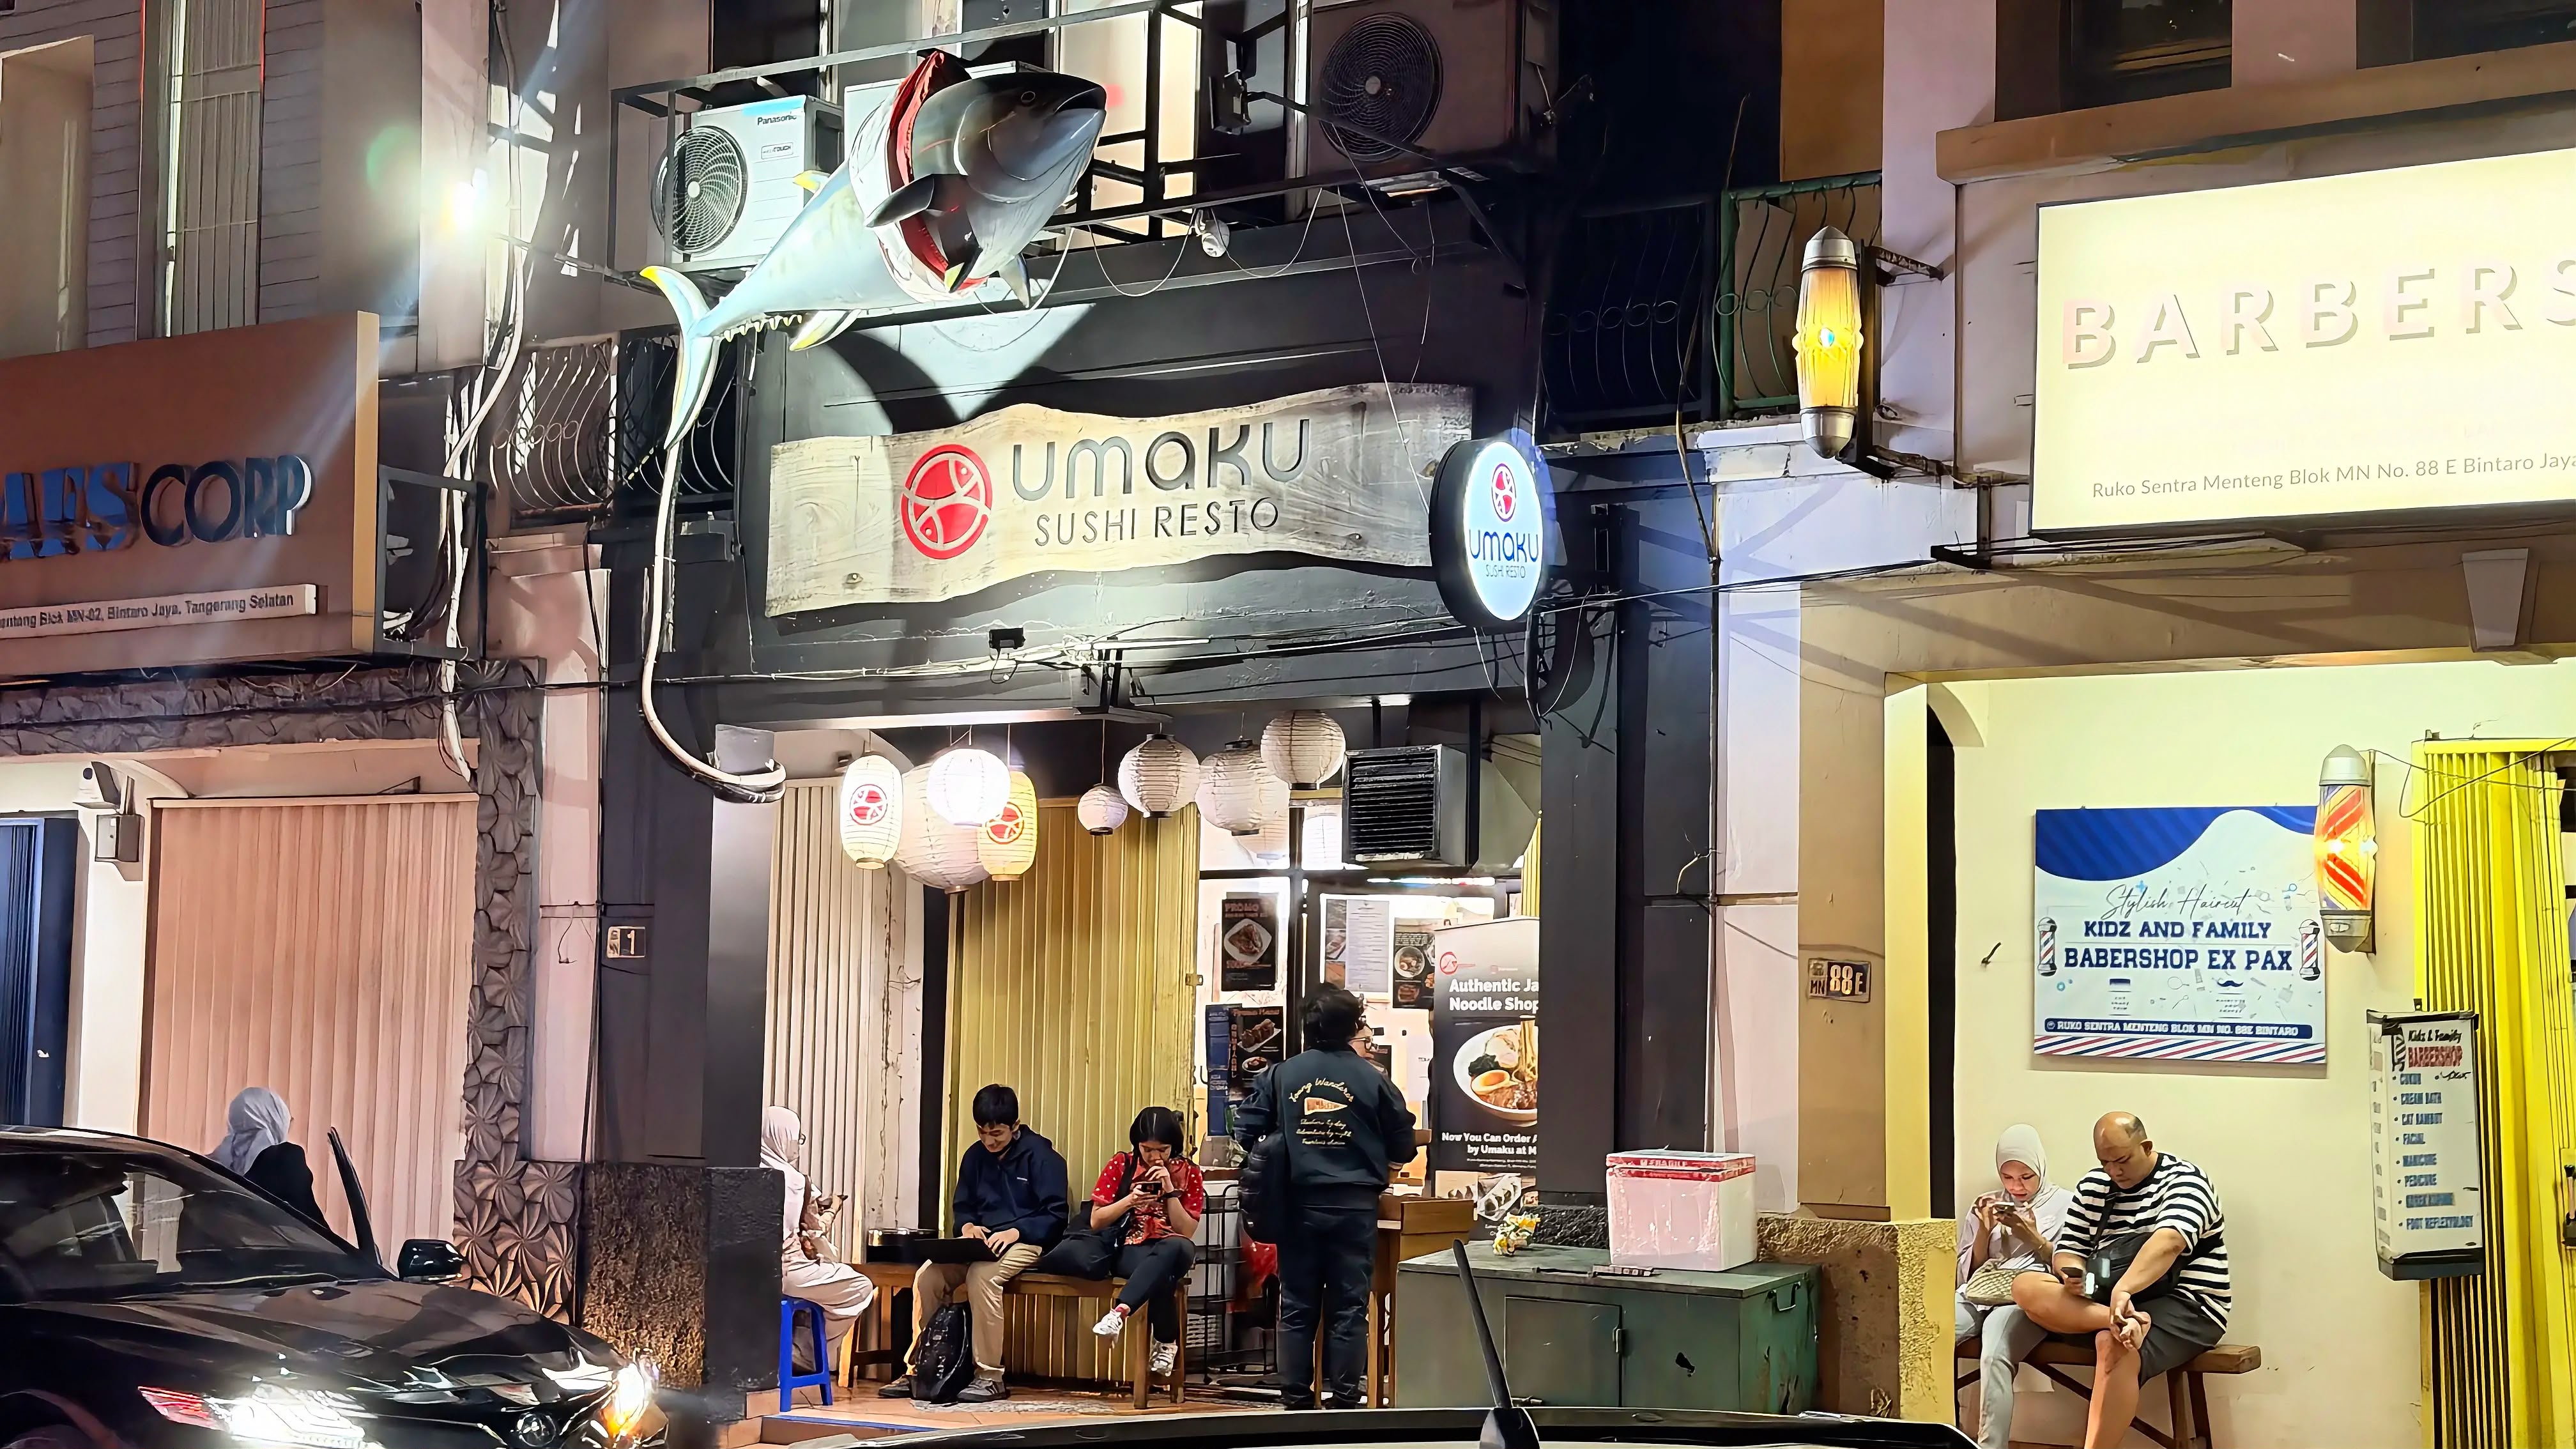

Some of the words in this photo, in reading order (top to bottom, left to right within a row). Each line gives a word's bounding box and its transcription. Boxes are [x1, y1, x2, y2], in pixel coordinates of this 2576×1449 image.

[758, 115, 797, 125] Panasonic
[2093, 481, 2135, 498] Ruko
[2141, 479, 2197, 494] Sentra
[2204, 474, 2283, 490] Menteng
[2290, 468, 2330, 485] Blok
[2336, 464, 2370, 482] MN
[2377, 463, 2409, 479] No.
[2416, 460, 2439, 477] 88
[2446, 459, 2457, 475] E
[2464, 457, 2534, 473] Bintaro
[1035, 508, 1135, 546] SUSHI
[1154, 496, 1278, 538] RESTO
[1485, 564, 1504, 578] SUSHI
[1505, 565, 1526, 578] RESTO
[249, 593, 294, 609] Selatan
[2101, 883, 2168, 920] Stylish
[2177, 884, 2251, 921] Haircut
[2084, 921, 2131, 937] KIDZ
[2138, 921, 2184, 938] AND
[2192, 921, 2272, 939] FAMILY
[2064, 947, 2199, 969] BABERSHOP
[2207, 949, 2237, 970] EX
[2244, 950, 2292, 971] PAX
[1449, 978, 1521, 992] Authentic
[1449, 997, 1503, 1011] Noodle
[2057, 1021, 2082, 1030] RUKO
[2084, 1022, 2121, 1031] SENTRA
[2123, 1022, 2169, 1032] MENTENG
[2170, 1023, 2195, 1033] BLOK
[2255, 1026, 2299, 1036] BINTARO
[1441, 1132, 1462, 1142] Now
[1462, 1133, 1482, 1142] You
[1483, 1133, 1501, 1142] Can
[1503, 1133, 1531, 1143] Order
[1467, 1144, 1479, 1156] by
[1480, 1145, 1514, 1154] Umaku
[1515, 1146, 1526, 1154] at
